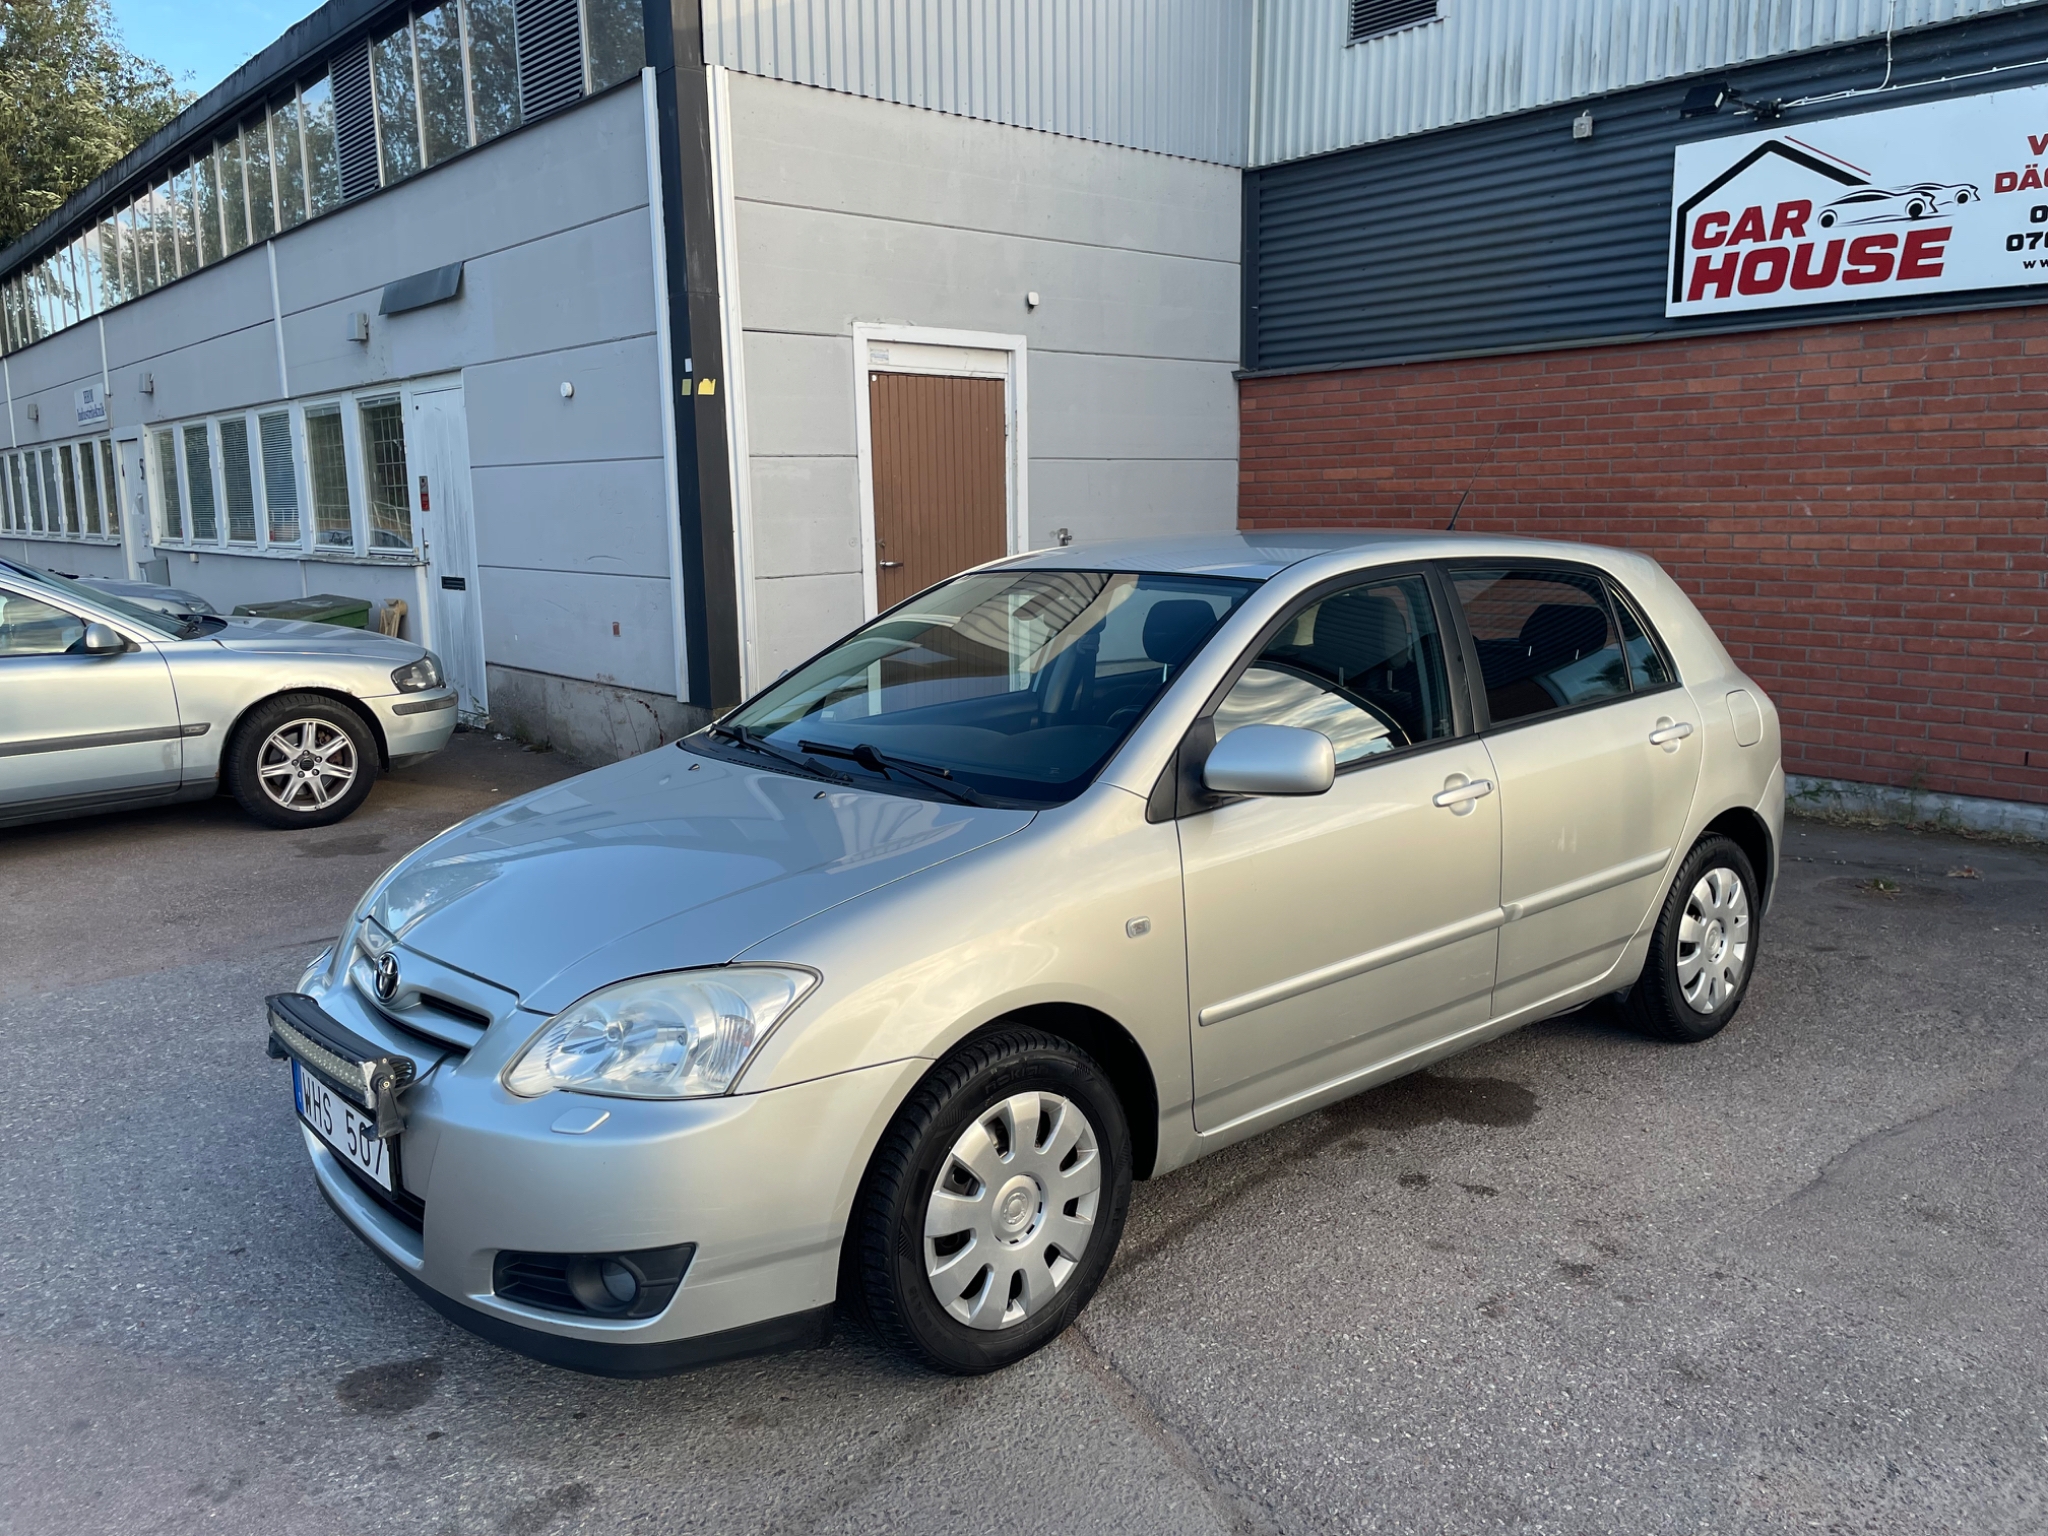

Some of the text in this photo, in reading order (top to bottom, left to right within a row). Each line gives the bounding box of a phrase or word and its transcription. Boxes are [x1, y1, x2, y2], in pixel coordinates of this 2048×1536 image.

[1994, 163, 2048, 194] DÄ
[1691, 199, 1812, 250] CAR
[2006, 231, 2048, 252] 07
[1687, 226, 1953, 301] HOUSE
[302, 1072, 333, 1136] WHS
